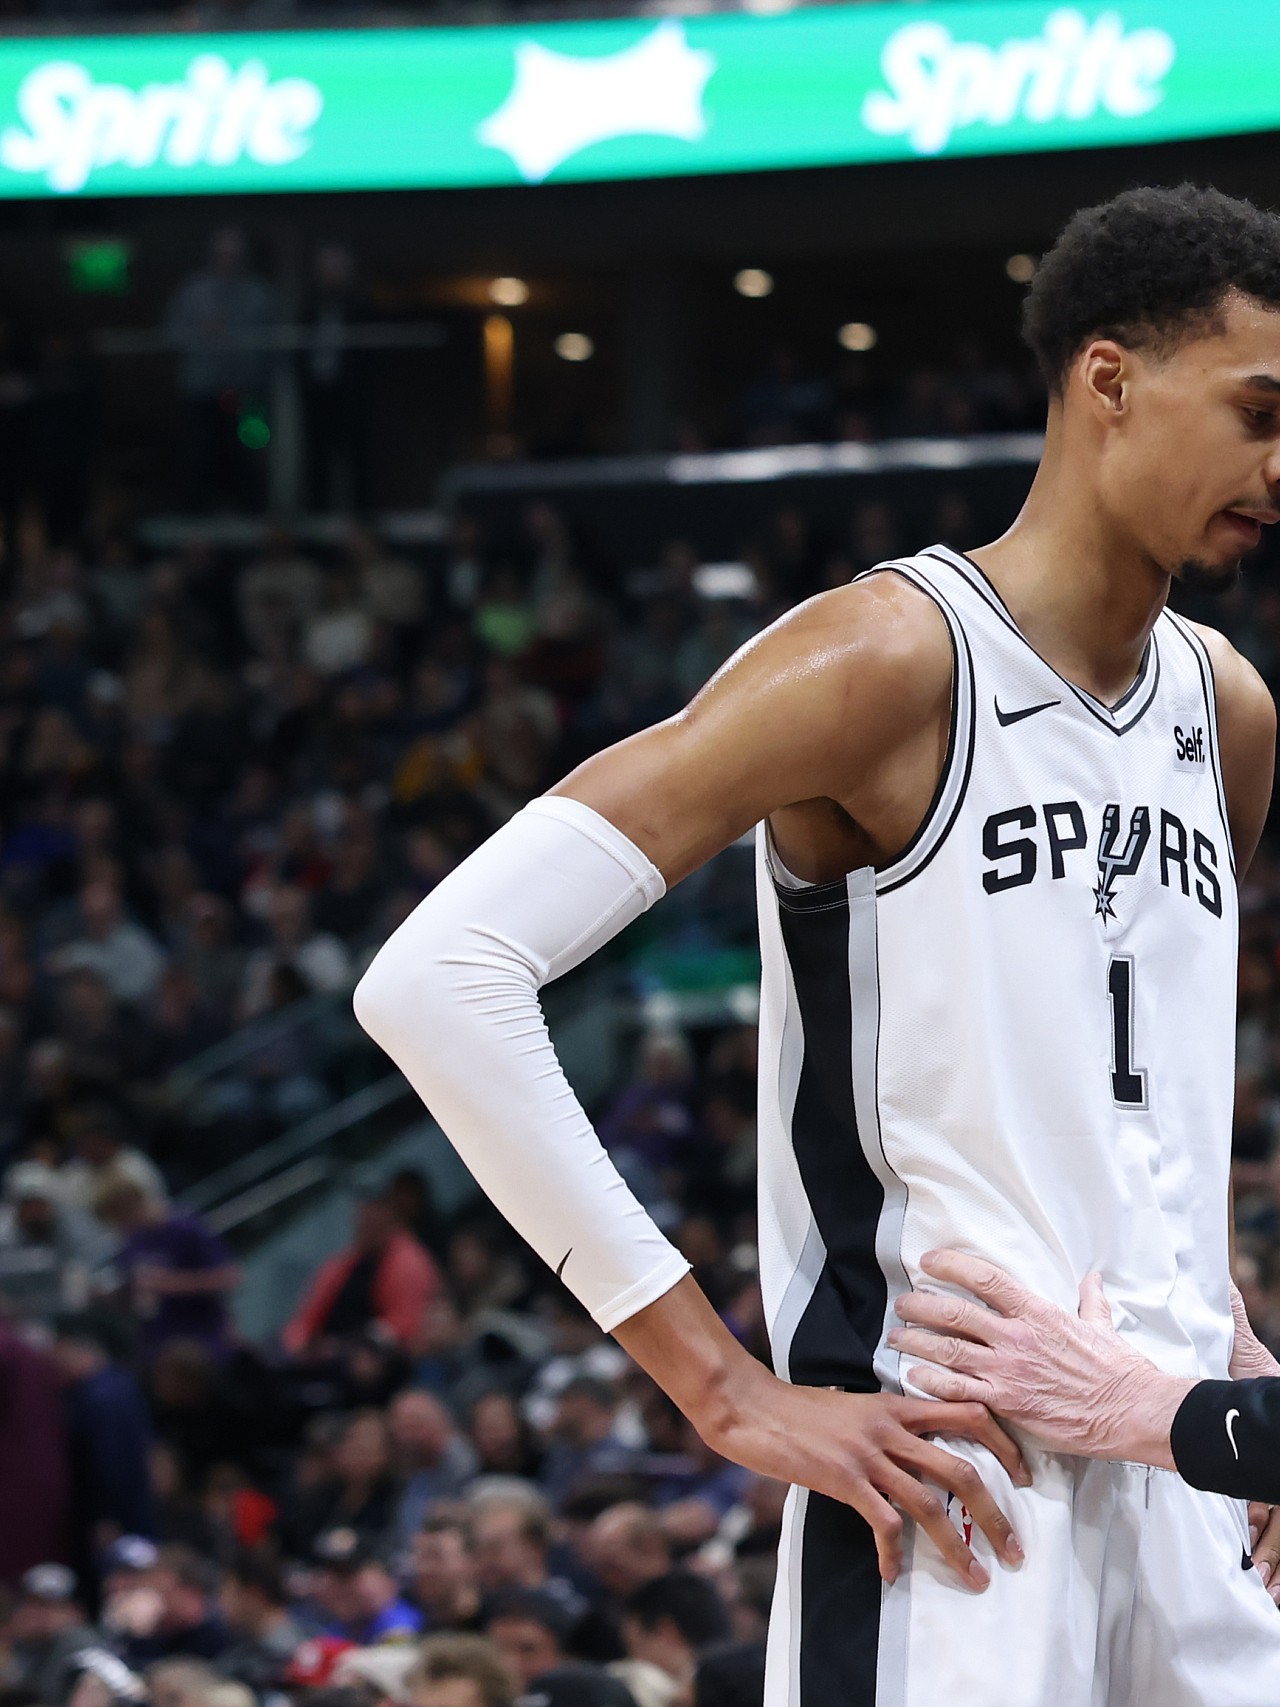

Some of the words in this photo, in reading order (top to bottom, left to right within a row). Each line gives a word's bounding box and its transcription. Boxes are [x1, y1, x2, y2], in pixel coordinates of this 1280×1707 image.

[0, 53, 324, 193] Sprite
[861, 7, 1176, 155] Sprite
[982, 801, 1222, 927] SPURS
[1106, 951, 1149, 1111] 1
